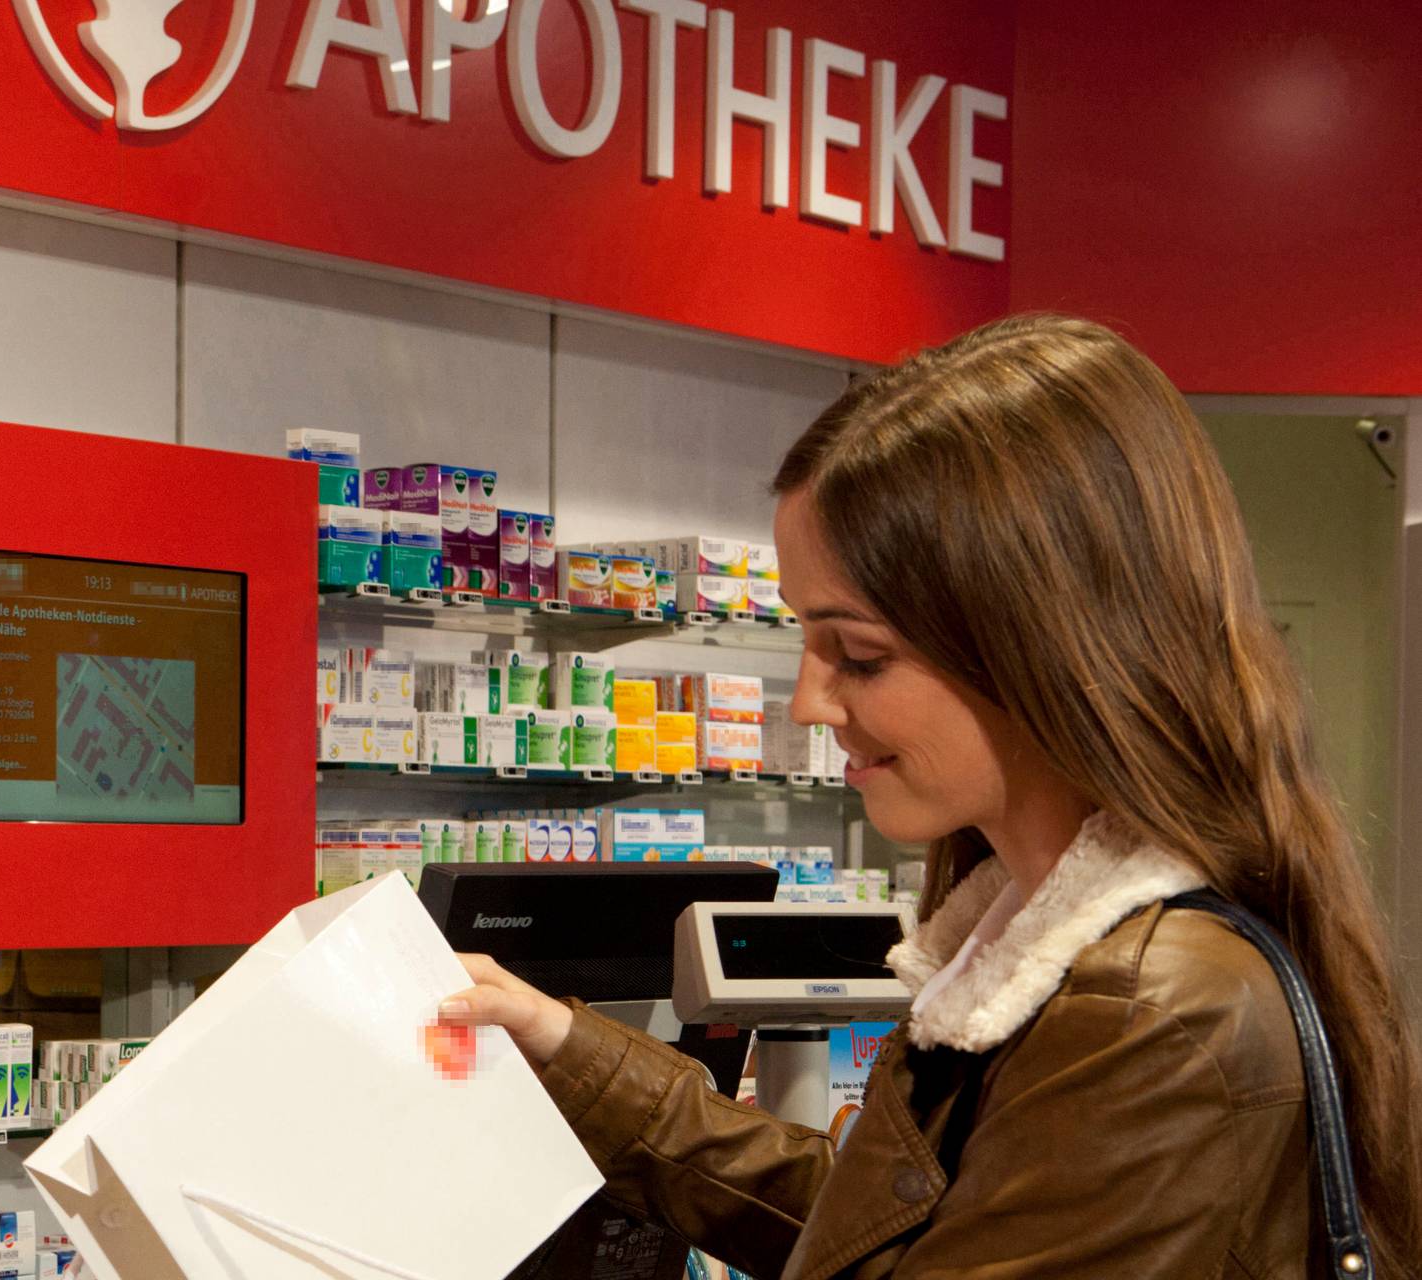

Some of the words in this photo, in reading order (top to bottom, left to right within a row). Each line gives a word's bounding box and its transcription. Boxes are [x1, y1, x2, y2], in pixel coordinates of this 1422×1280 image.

[284, 0, 1007, 262] APOTHEKE
[84, 575, 111, 590] 19:13
[190, 587, 238, 602] APOTHEKE
[326, 670, 337, 697] C
[401, 671, 411, 697] C
[362, 728, 373, 753] C
[403, 731, 414, 755] C
[472, 913, 534, 929] lenovo
[812, 986, 840, 994] EPSON
